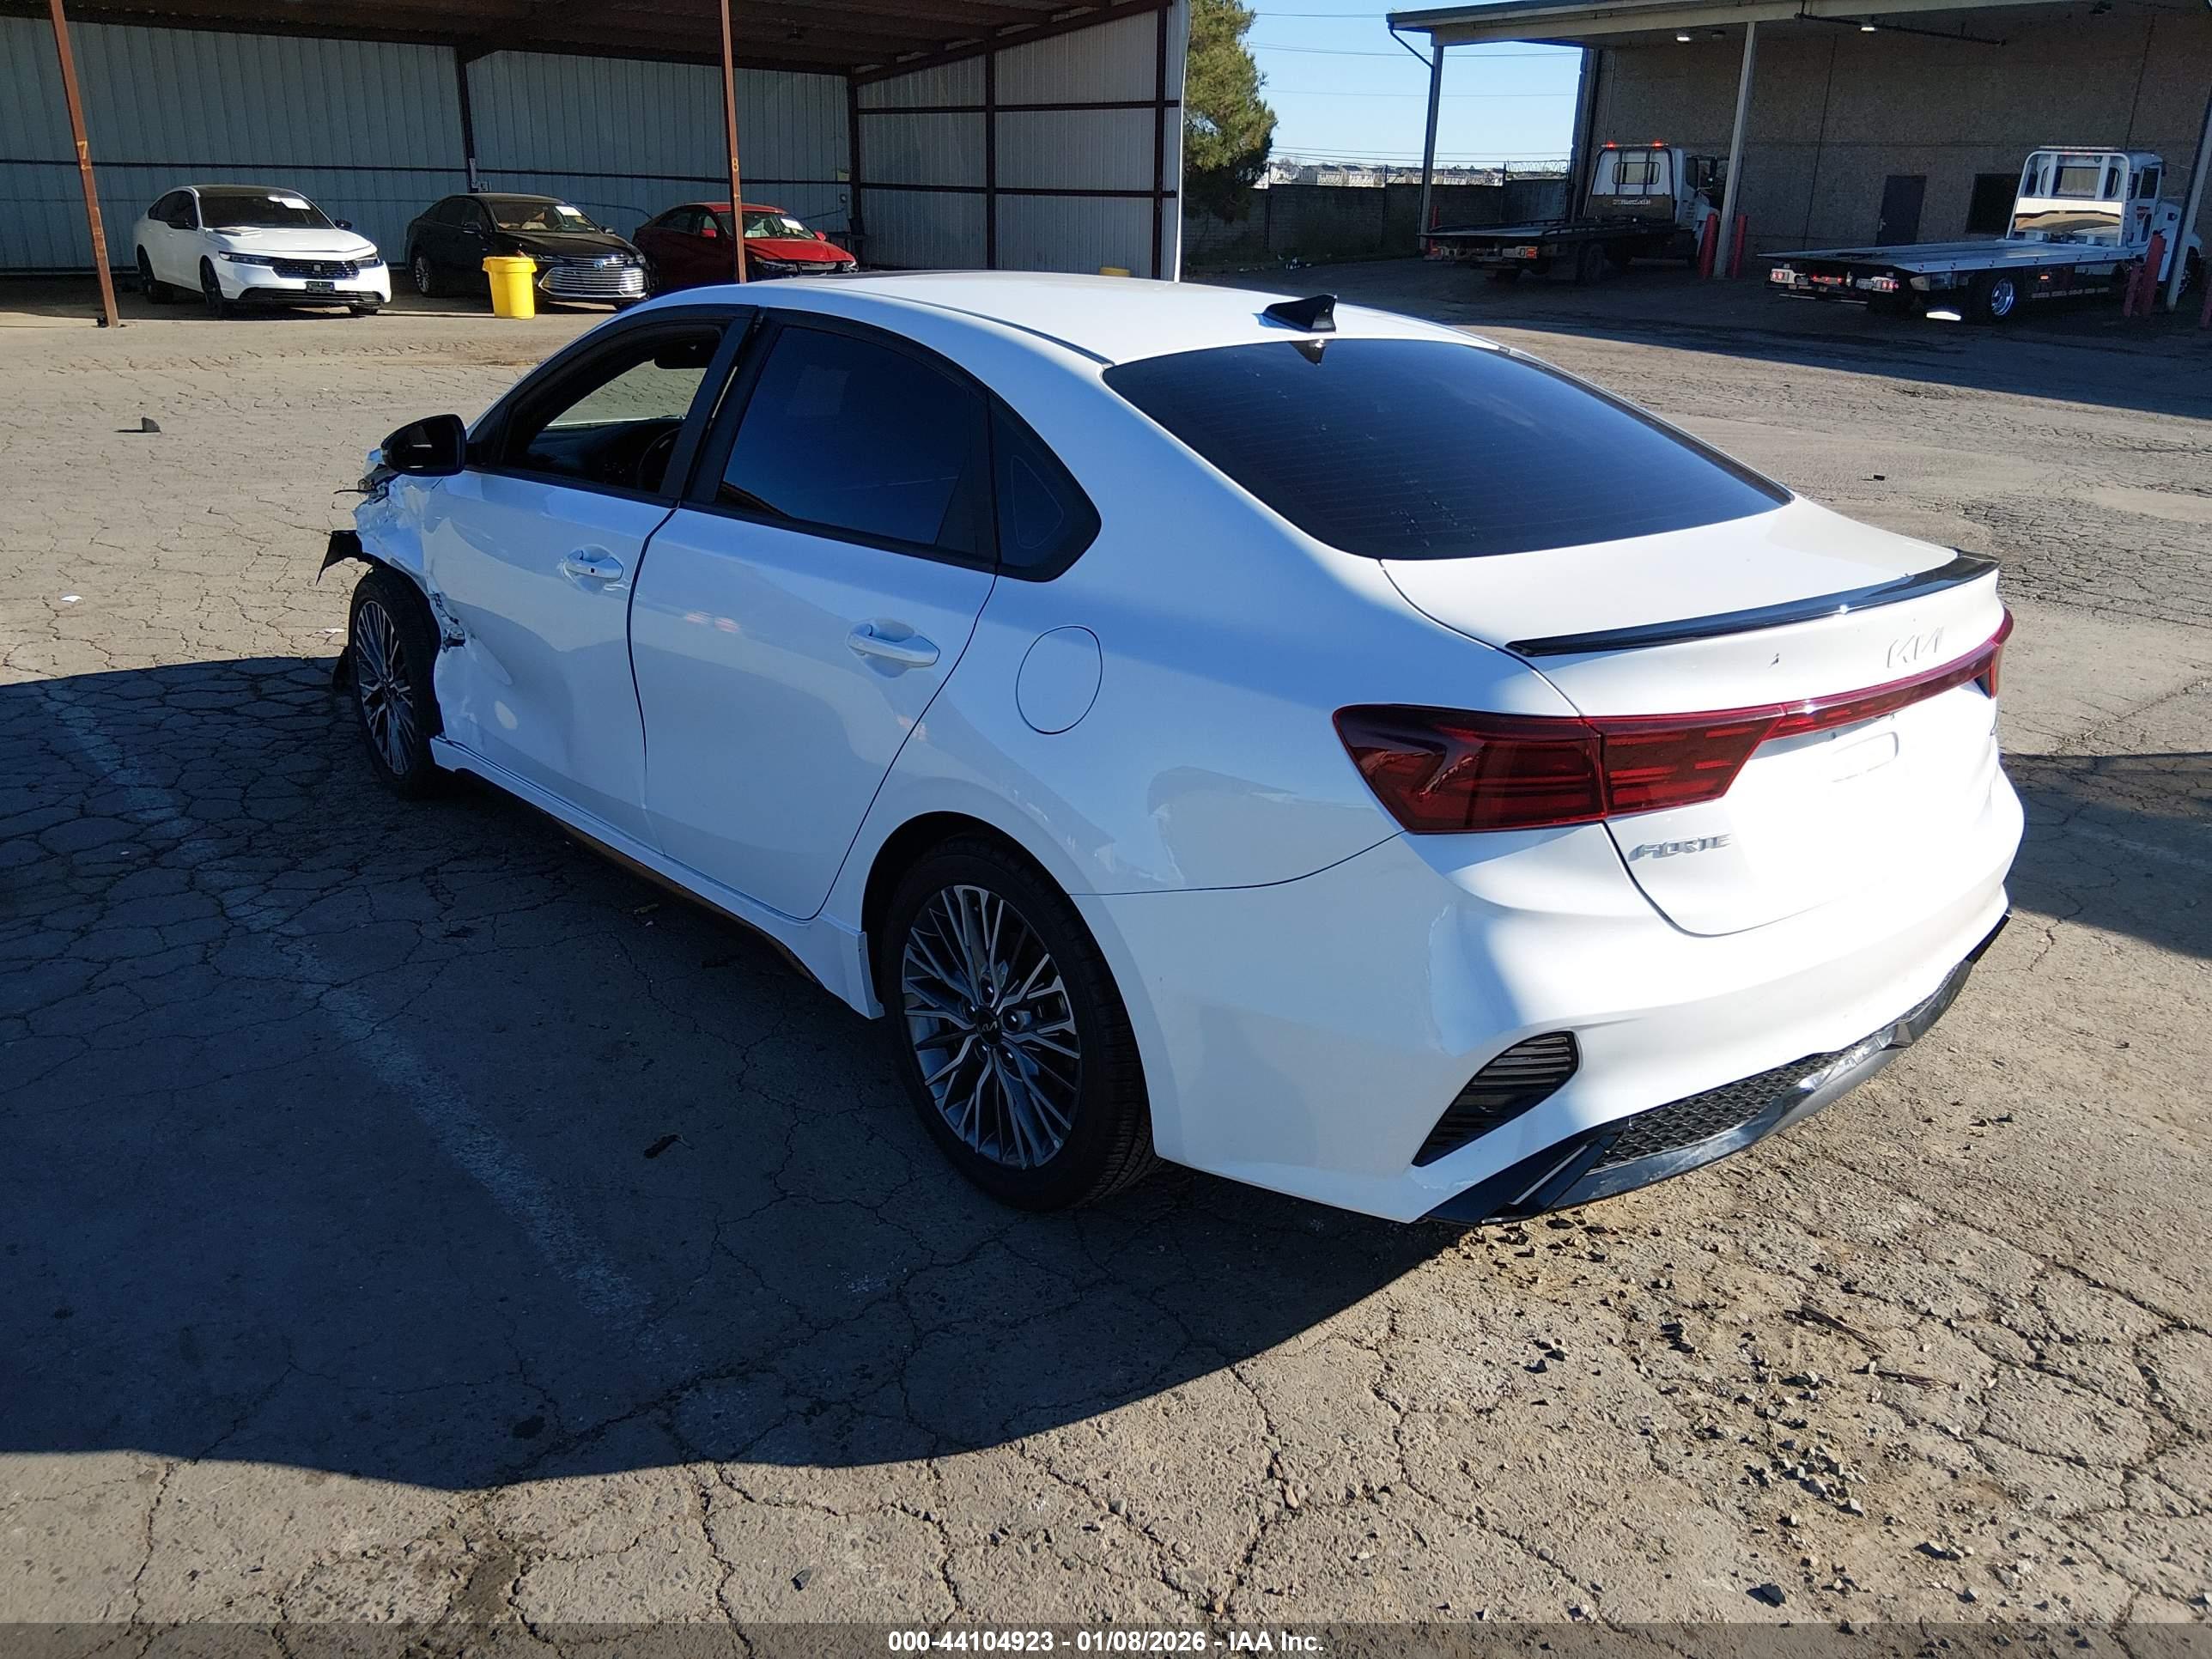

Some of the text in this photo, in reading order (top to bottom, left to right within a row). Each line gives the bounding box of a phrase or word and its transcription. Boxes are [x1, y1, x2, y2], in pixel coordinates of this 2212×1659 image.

[76, 140, 88, 160] 7
[732, 157, 739, 172] 8
[1887, 625, 1945, 668] KIA
[1627, 833, 1732, 862] FORTE
